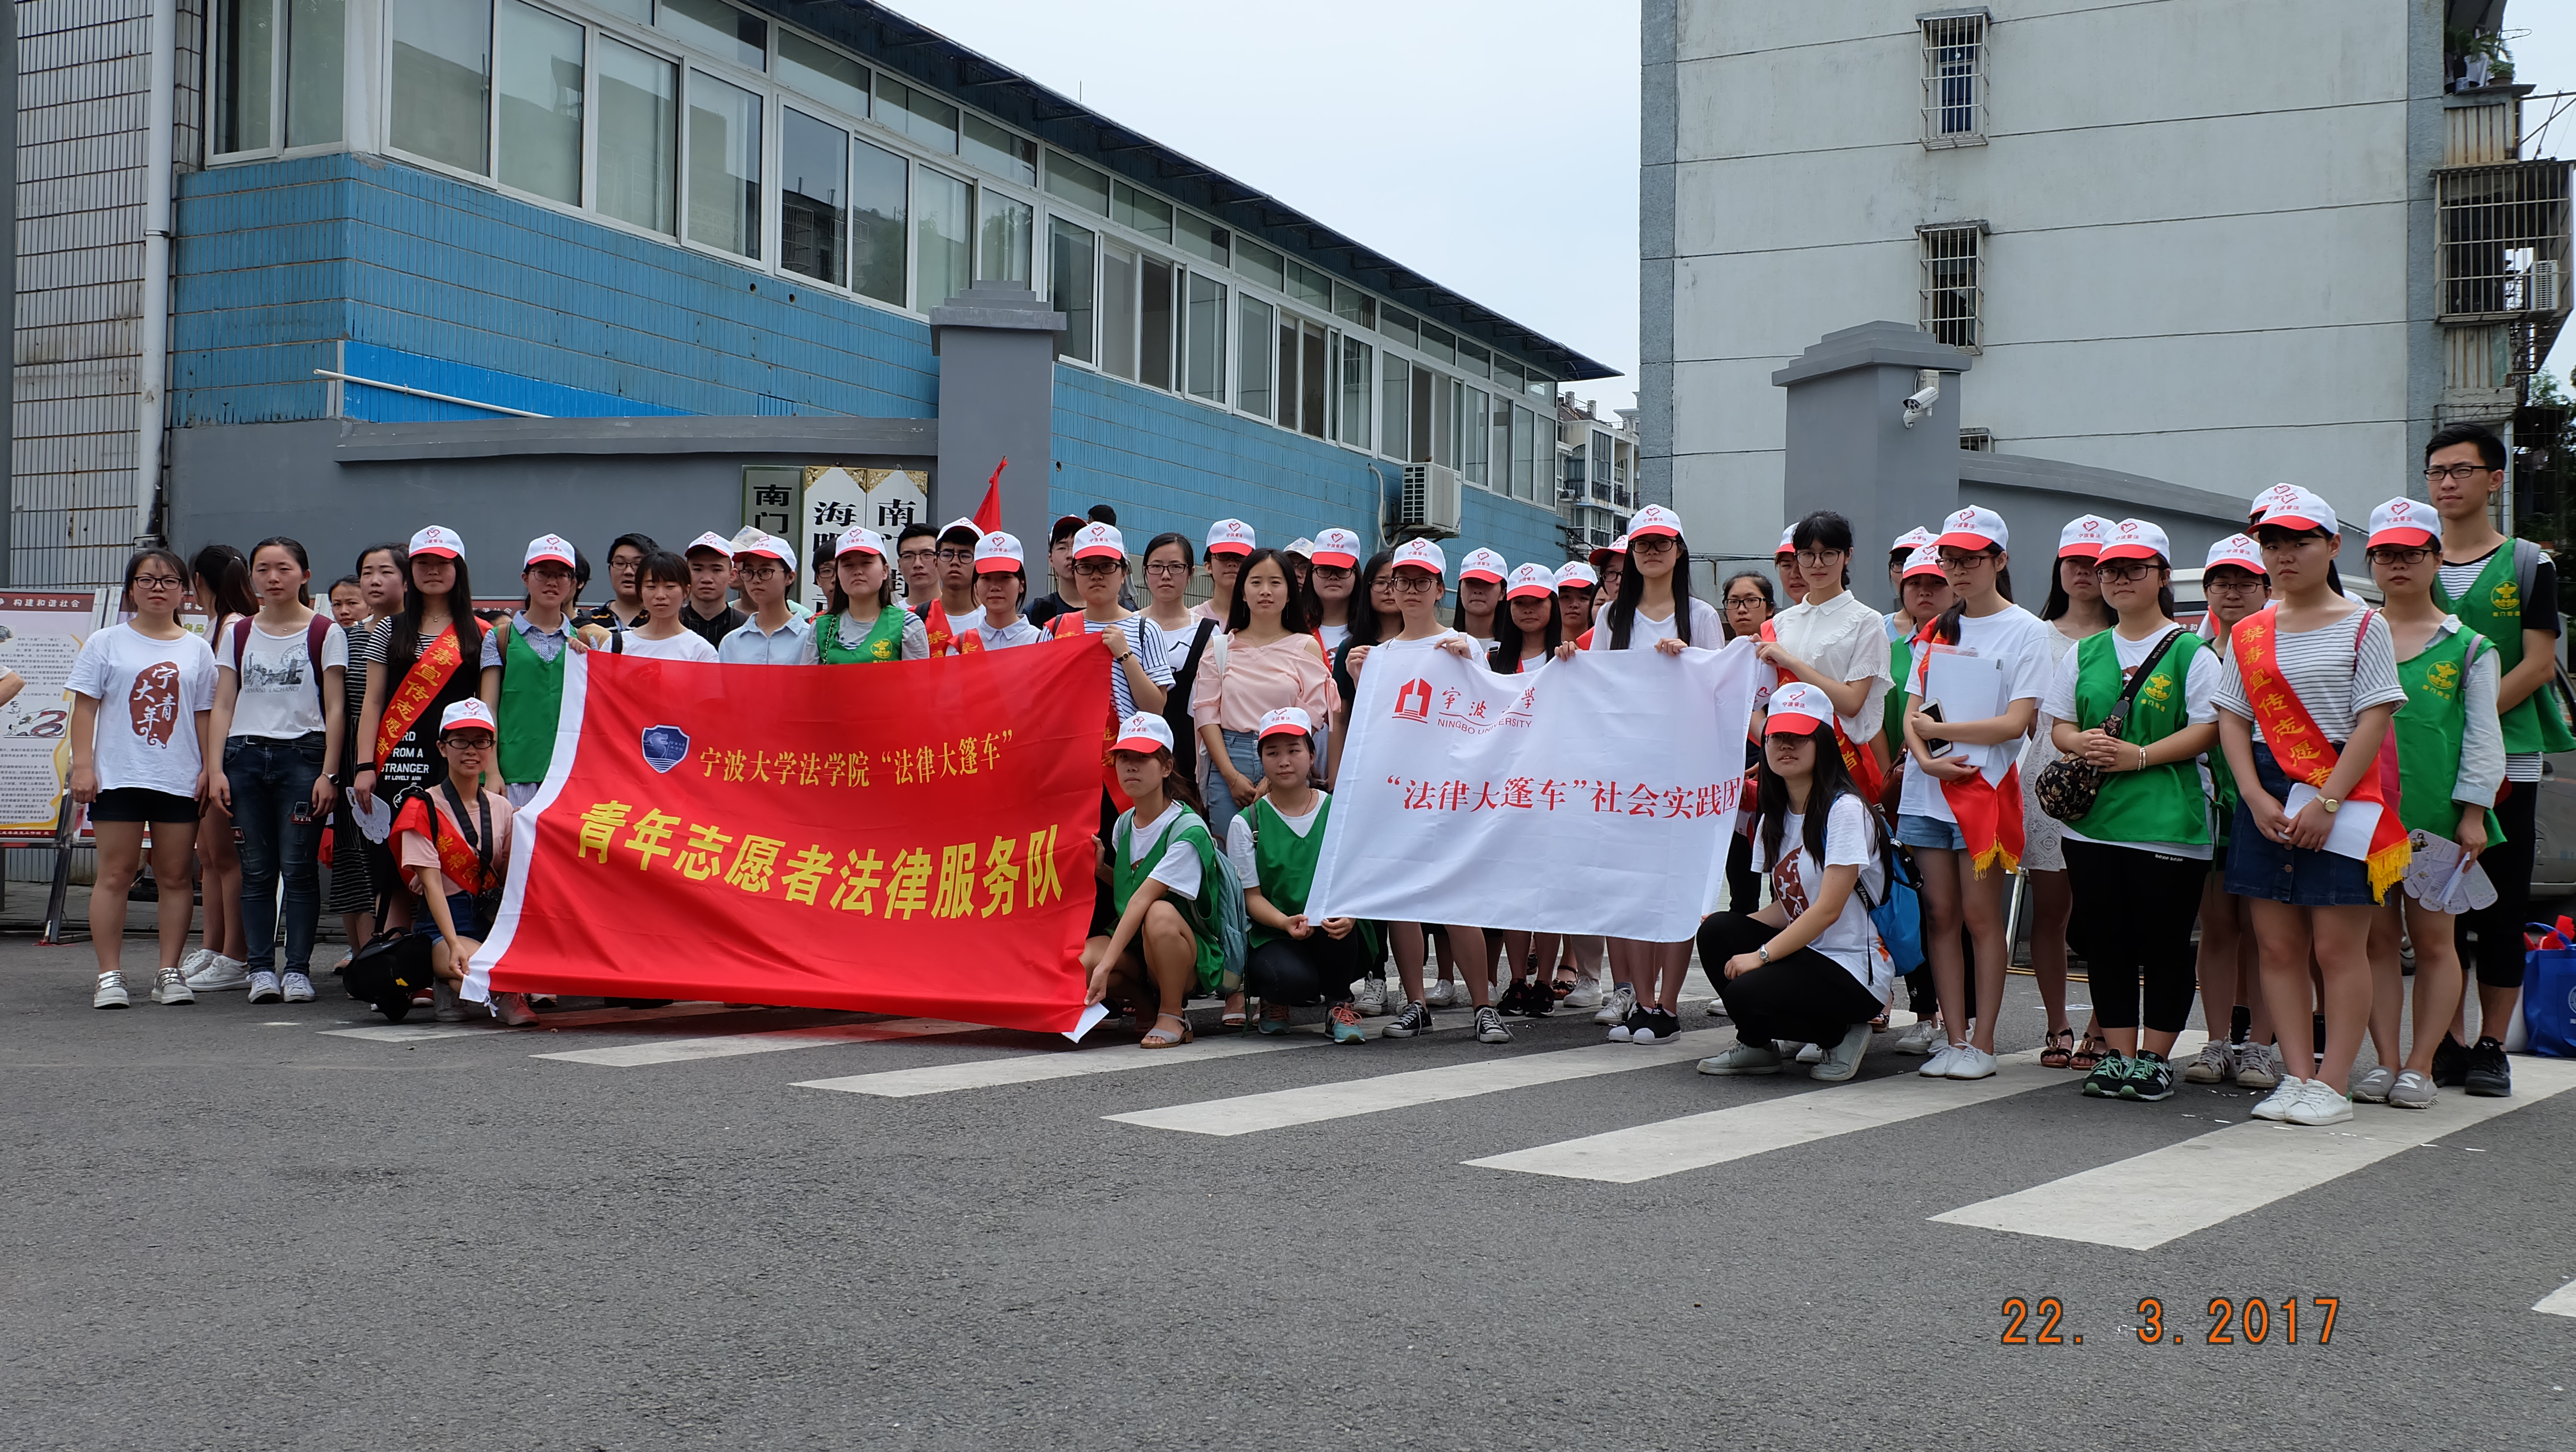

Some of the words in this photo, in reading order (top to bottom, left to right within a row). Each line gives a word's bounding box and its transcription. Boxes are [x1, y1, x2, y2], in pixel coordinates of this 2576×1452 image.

[13, 599, 80, 608] 构建和谐社会
[2240, 624, 2334, 788] 禁毒宣传志愿者
[1437, 719, 1475, 734] NINGBO
[1477, 718, 1532, 734] UNIVERSITY
[400, 731, 416, 741] RD
[389, 748, 415, 758] ROM
[417, 748, 424, 758] A
[700, 747, 870, 787] 宁波大学法学院
[882, 729, 1012, 784] “法律大篷车”
[578, 800, 1062, 920] 青年志愿者法律服务队
